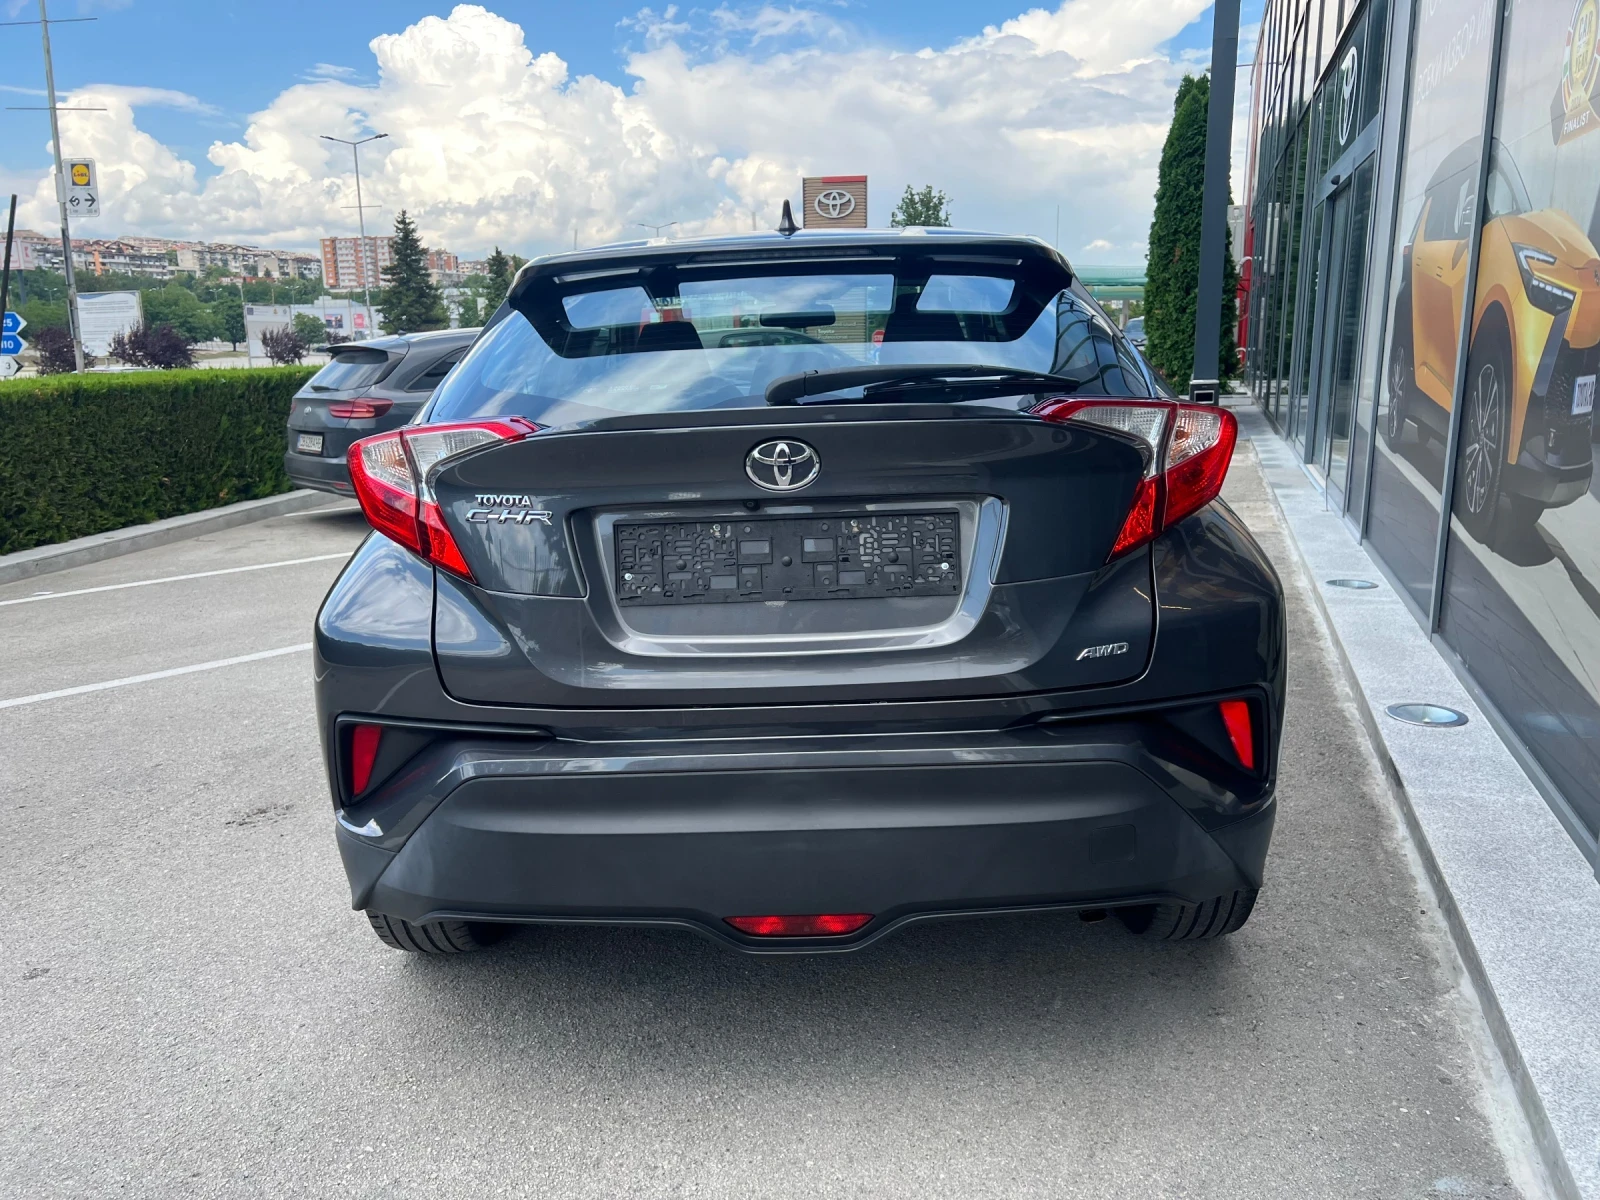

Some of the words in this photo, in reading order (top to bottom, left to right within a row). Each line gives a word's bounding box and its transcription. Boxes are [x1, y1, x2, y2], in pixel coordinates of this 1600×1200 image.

[1563, 110, 1591, 135] FINALIST
[475, 494, 533, 508] TOYOTA
[465, 509, 553, 526] C-HR
[1076, 642, 1129, 661] AWD
